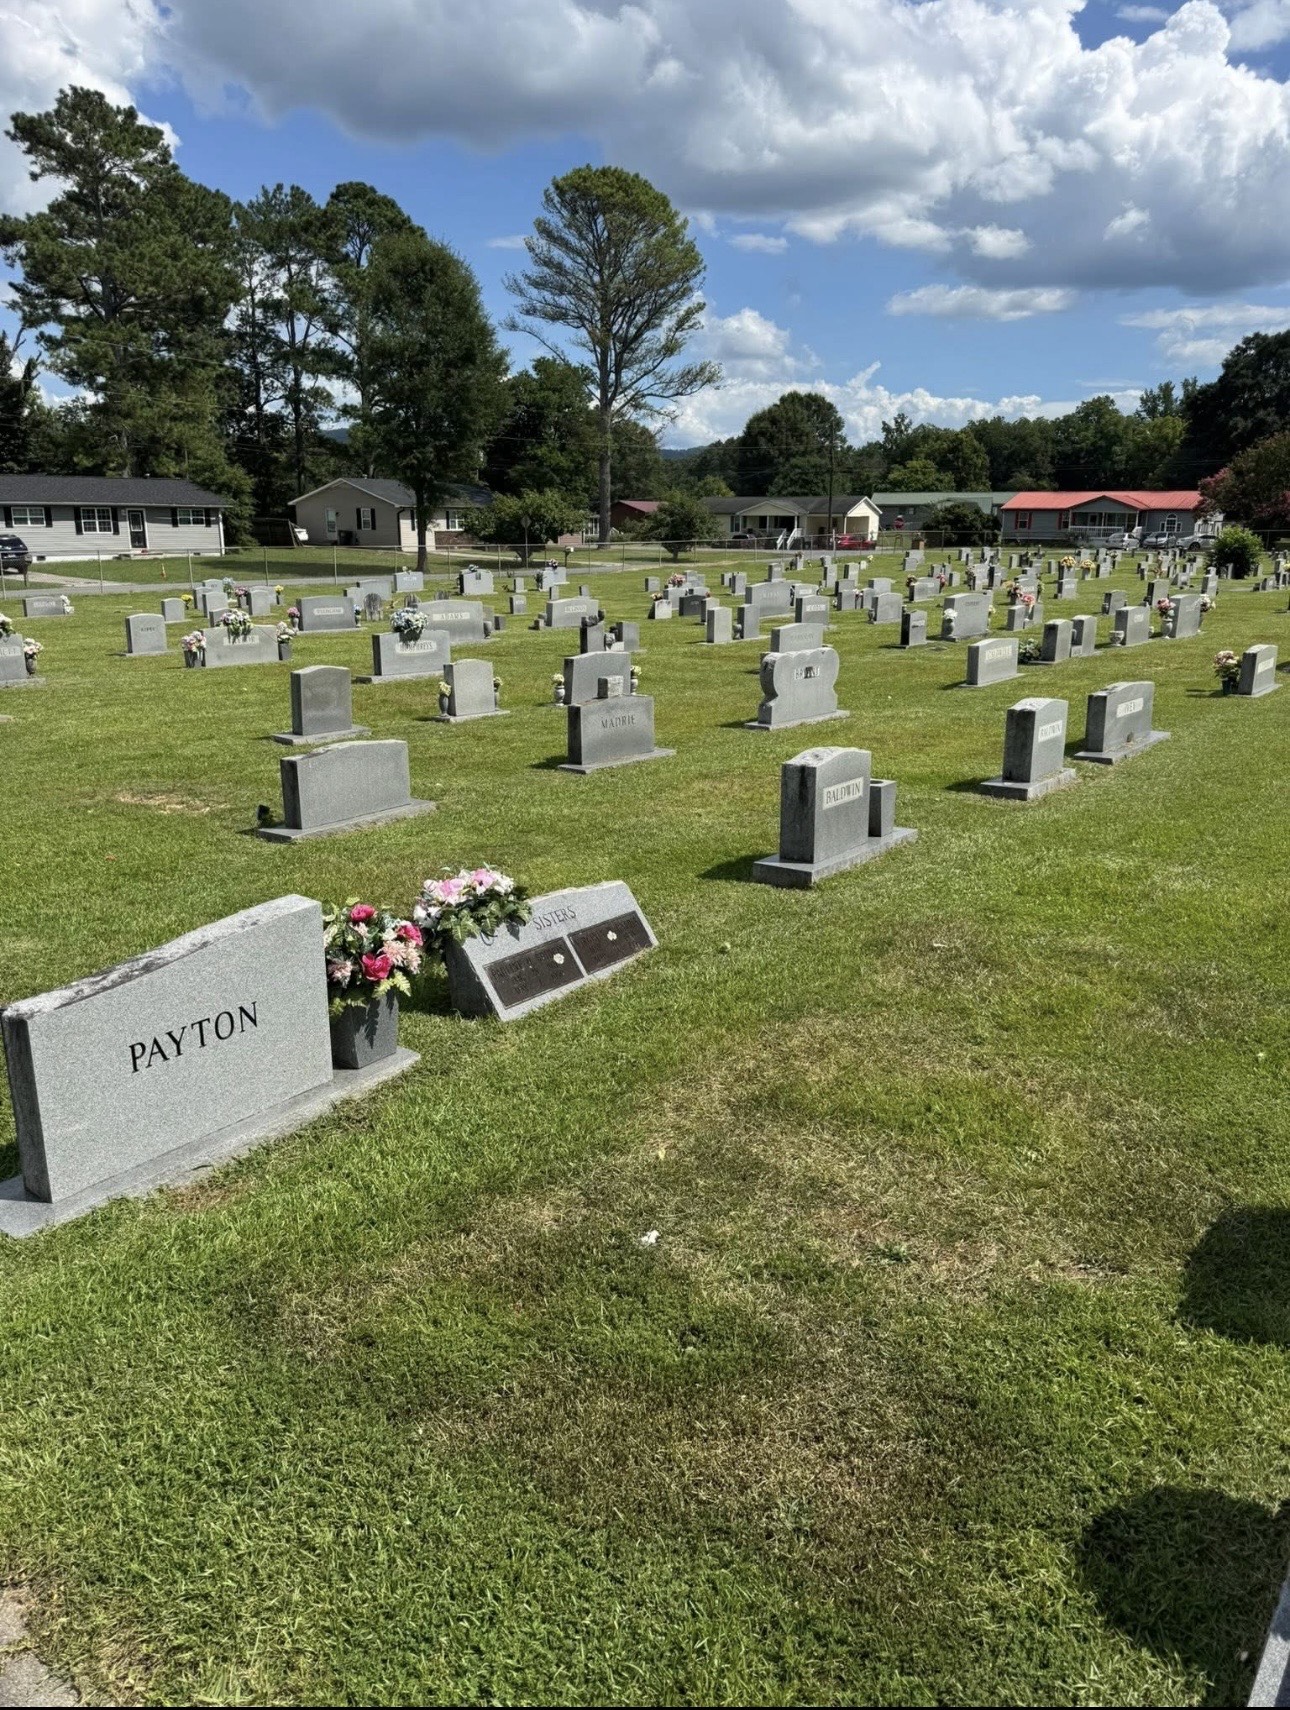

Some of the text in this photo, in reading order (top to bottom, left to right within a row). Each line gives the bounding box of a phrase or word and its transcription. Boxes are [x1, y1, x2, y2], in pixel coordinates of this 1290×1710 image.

[601, 714, 637, 729] MADRIE
[825, 780, 862, 805] BALDWIN
[533, 906, 578, 931] SISTERS
[128, 1001, 259, 1073] PAYTON
